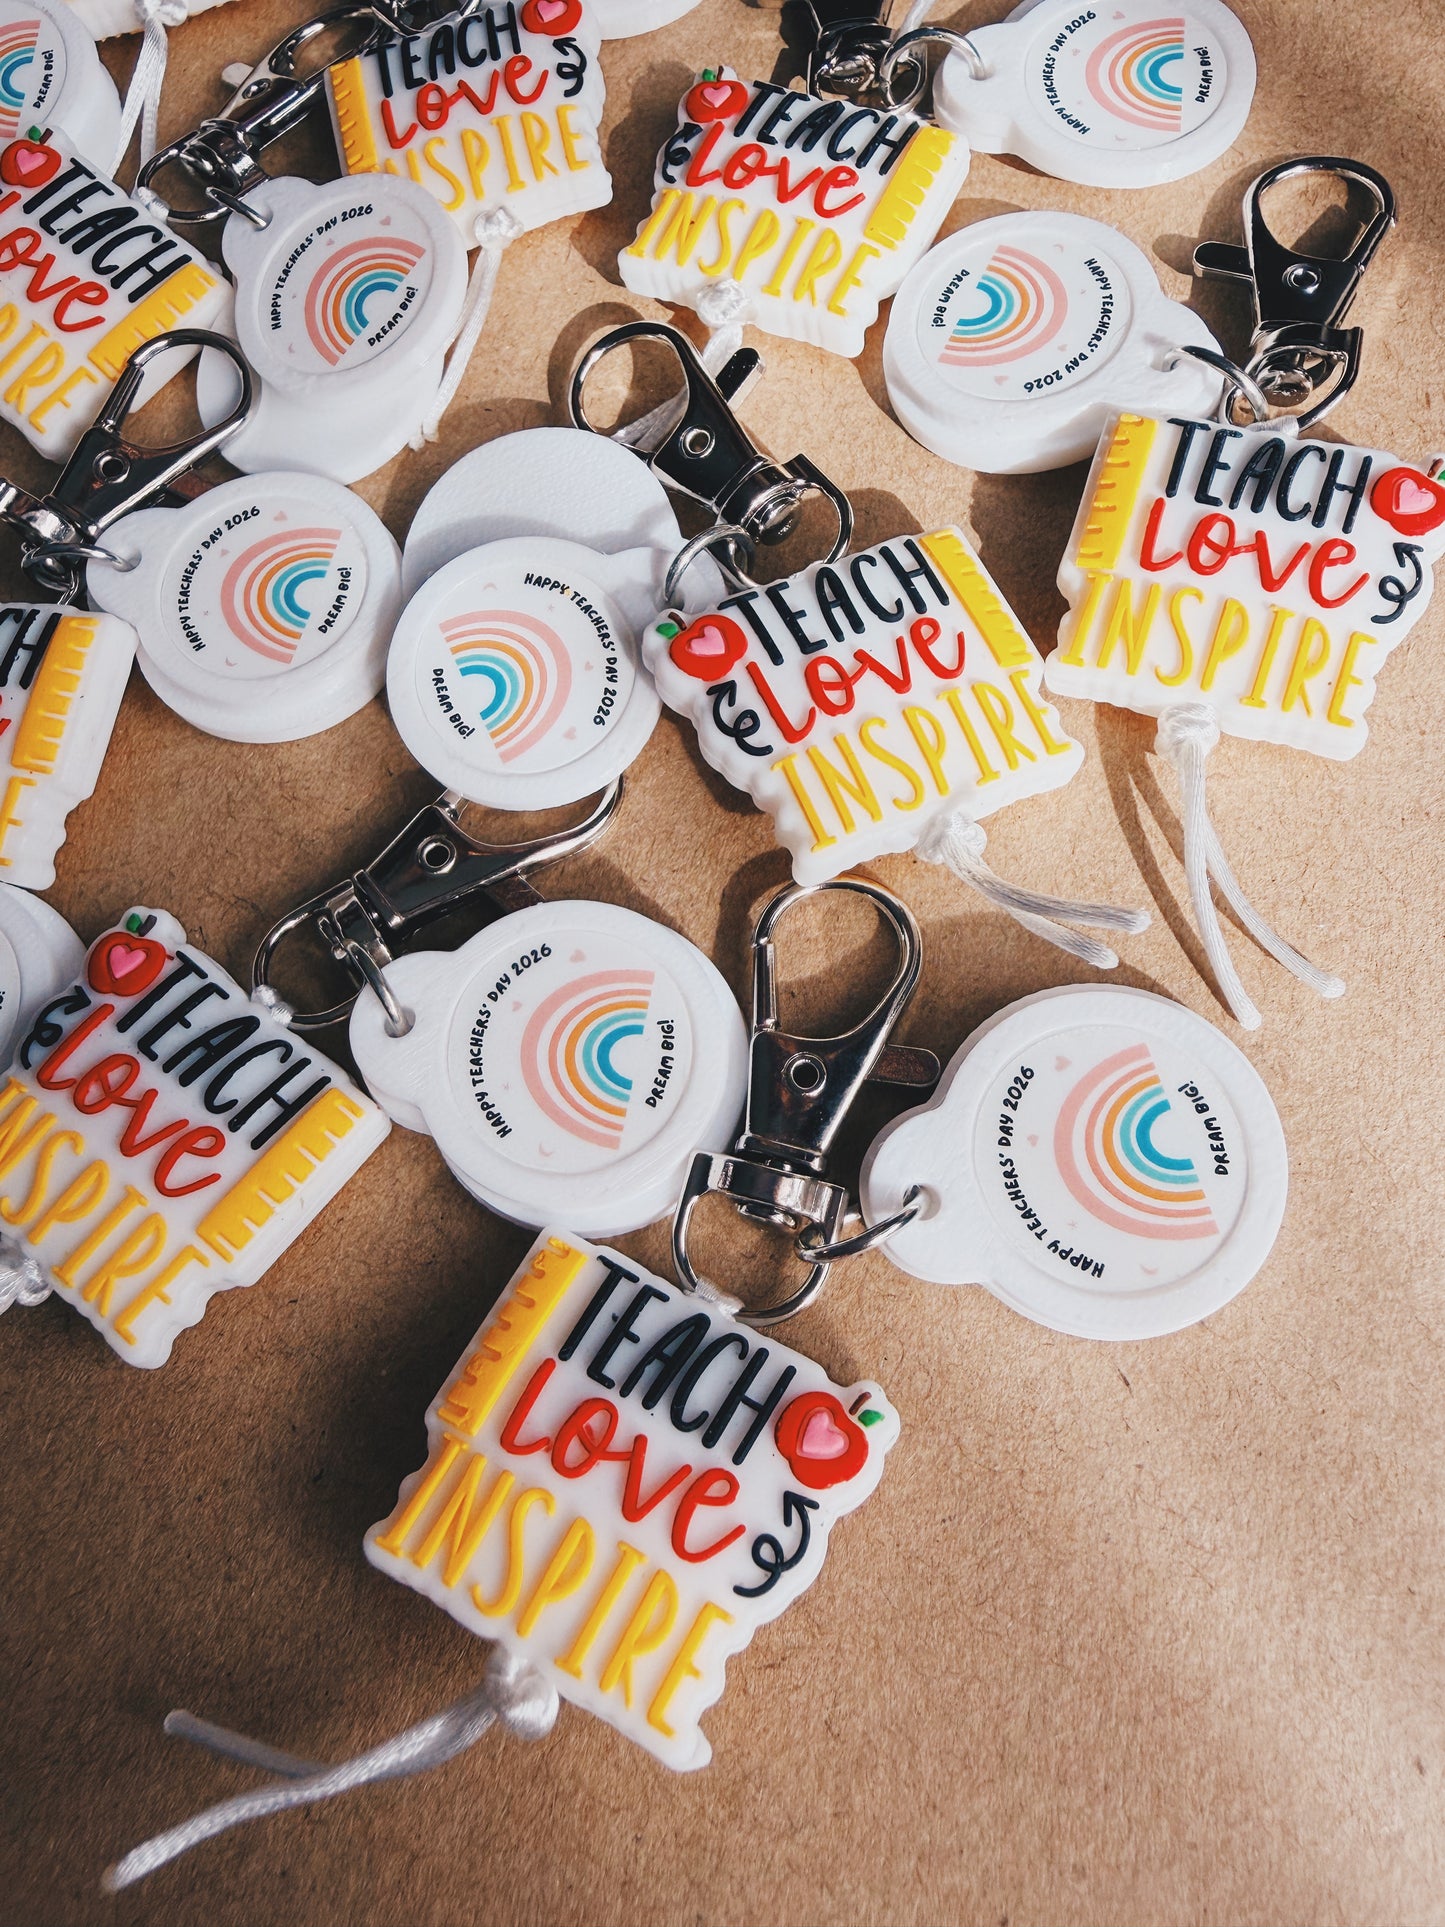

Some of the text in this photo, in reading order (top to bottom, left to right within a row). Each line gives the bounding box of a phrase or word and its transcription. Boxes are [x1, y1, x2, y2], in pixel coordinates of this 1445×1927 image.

[364, 1, 522, 98] TEACH
[1050, 33, 1067, 51] DAY
[1065, 11, 1096, 33] 2026
[33, 74, 53, 108] DREAM
[1193, 47, 1213, 102] DREAM BIG!
[734, 80, 919, 175] TEACH
[1055, 108, 1090, 134] HAPPY
[23, 158, 192, 303] TEACH
[627, 189, 880, 316] INSPIRE
[271, 294, 281, 330] HAPPY
[316, 217, 337, 235] DAY
[341, 204, 373, 222] 2026
[1084, 258, 1111, 290] HAPPY
[368, 287, 418, 346] DREAM BIG!
[932, 270, 969, 327] DREAM BIG!
[1024, 370, 1062, 392] 2026
[1065, 353, 1088, 373] DAY
[1166, 418, 1372, 534] TEACH
[180, 616, 206, 651] HAPPY
[201, 528, 222, 549] DAY
[225, 506, 260, 530] 2026
[318, 568, 351, 633] DREAM BIG!
[524, 573, 569, 594] HAPPY
[717, 539, 949, 666] TEACH
[606, 657, 617, 683] DAY
[1060, 572, 1378, 727] INSPIRE
[432, 669, 475, 739] DREAM BIG!
[594, 688, 616, 725] 2026
[771, 670, 1071, 852] INSPIRE
[487, 974, 510, 1002] DAY
[512, 944, 551, 976] 2026
[115, 951, 331, 1150] TEACH
[645, 1020, 674, 1107] DREAM BIG!
[475, 1092, 512, 1138] HAPPY
[1003, 1066, 1034, 1111] 2026
[998, 1114, 1013, 1146] DAY
[1178, 1081, 1229, 1175] DREAM BIG!
[1047, 1240, 1104, 1278] HAPPY
[558, 1255, 796, 1465] TEACH
[375, 1432, 735, 1738] INSPIRE
